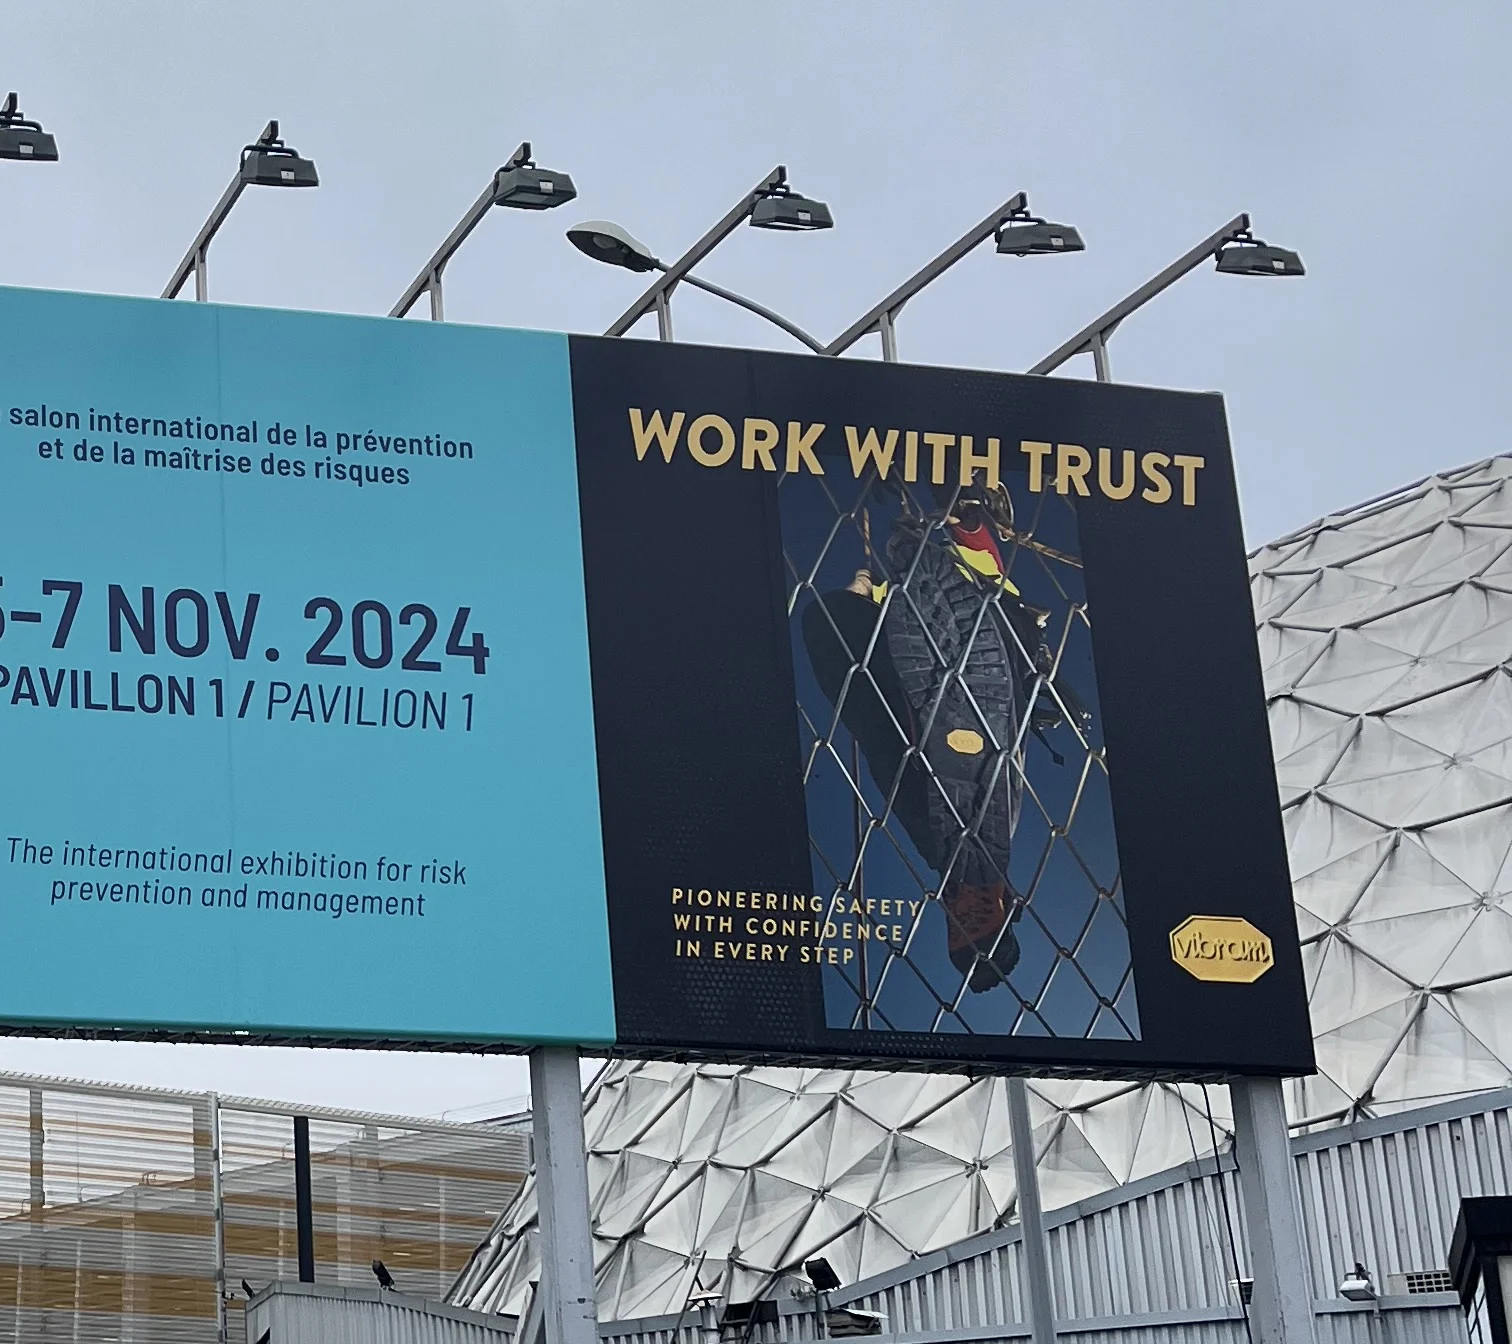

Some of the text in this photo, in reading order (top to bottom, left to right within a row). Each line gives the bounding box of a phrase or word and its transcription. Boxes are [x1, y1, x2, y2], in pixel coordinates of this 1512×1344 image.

[9, 403, 80, 430] salon
[89, 407, 258, 444] international
[266, 422, 297, 446] de
[305, 424, 327, 449] la
[336, 429, 473, 459] prévention
[38, 438, 410, 488] et de la maîtrise des risques
[629, 408, 1205, 506] WORK WITH TRUST
[108, 583, 280, 662] NOV.
[303, 596, 489, 675] 2024
[208, 678, 224, 718] 1
[267, 681, 447, 730] PAVILION
[461, 693, 474, 732] 1
[7, 837, 466, 886] The international exhibition for risk
[50, 878, 426, 919] prevention and management
[671, 887, 922, 918] PIONEERING SAFETY
[674, 914, 902, 943] WITH CONFIDENCE
[675, 939, 855, 965] IN EVERY STEP
[1176, 931, 1271, 964] vibram
